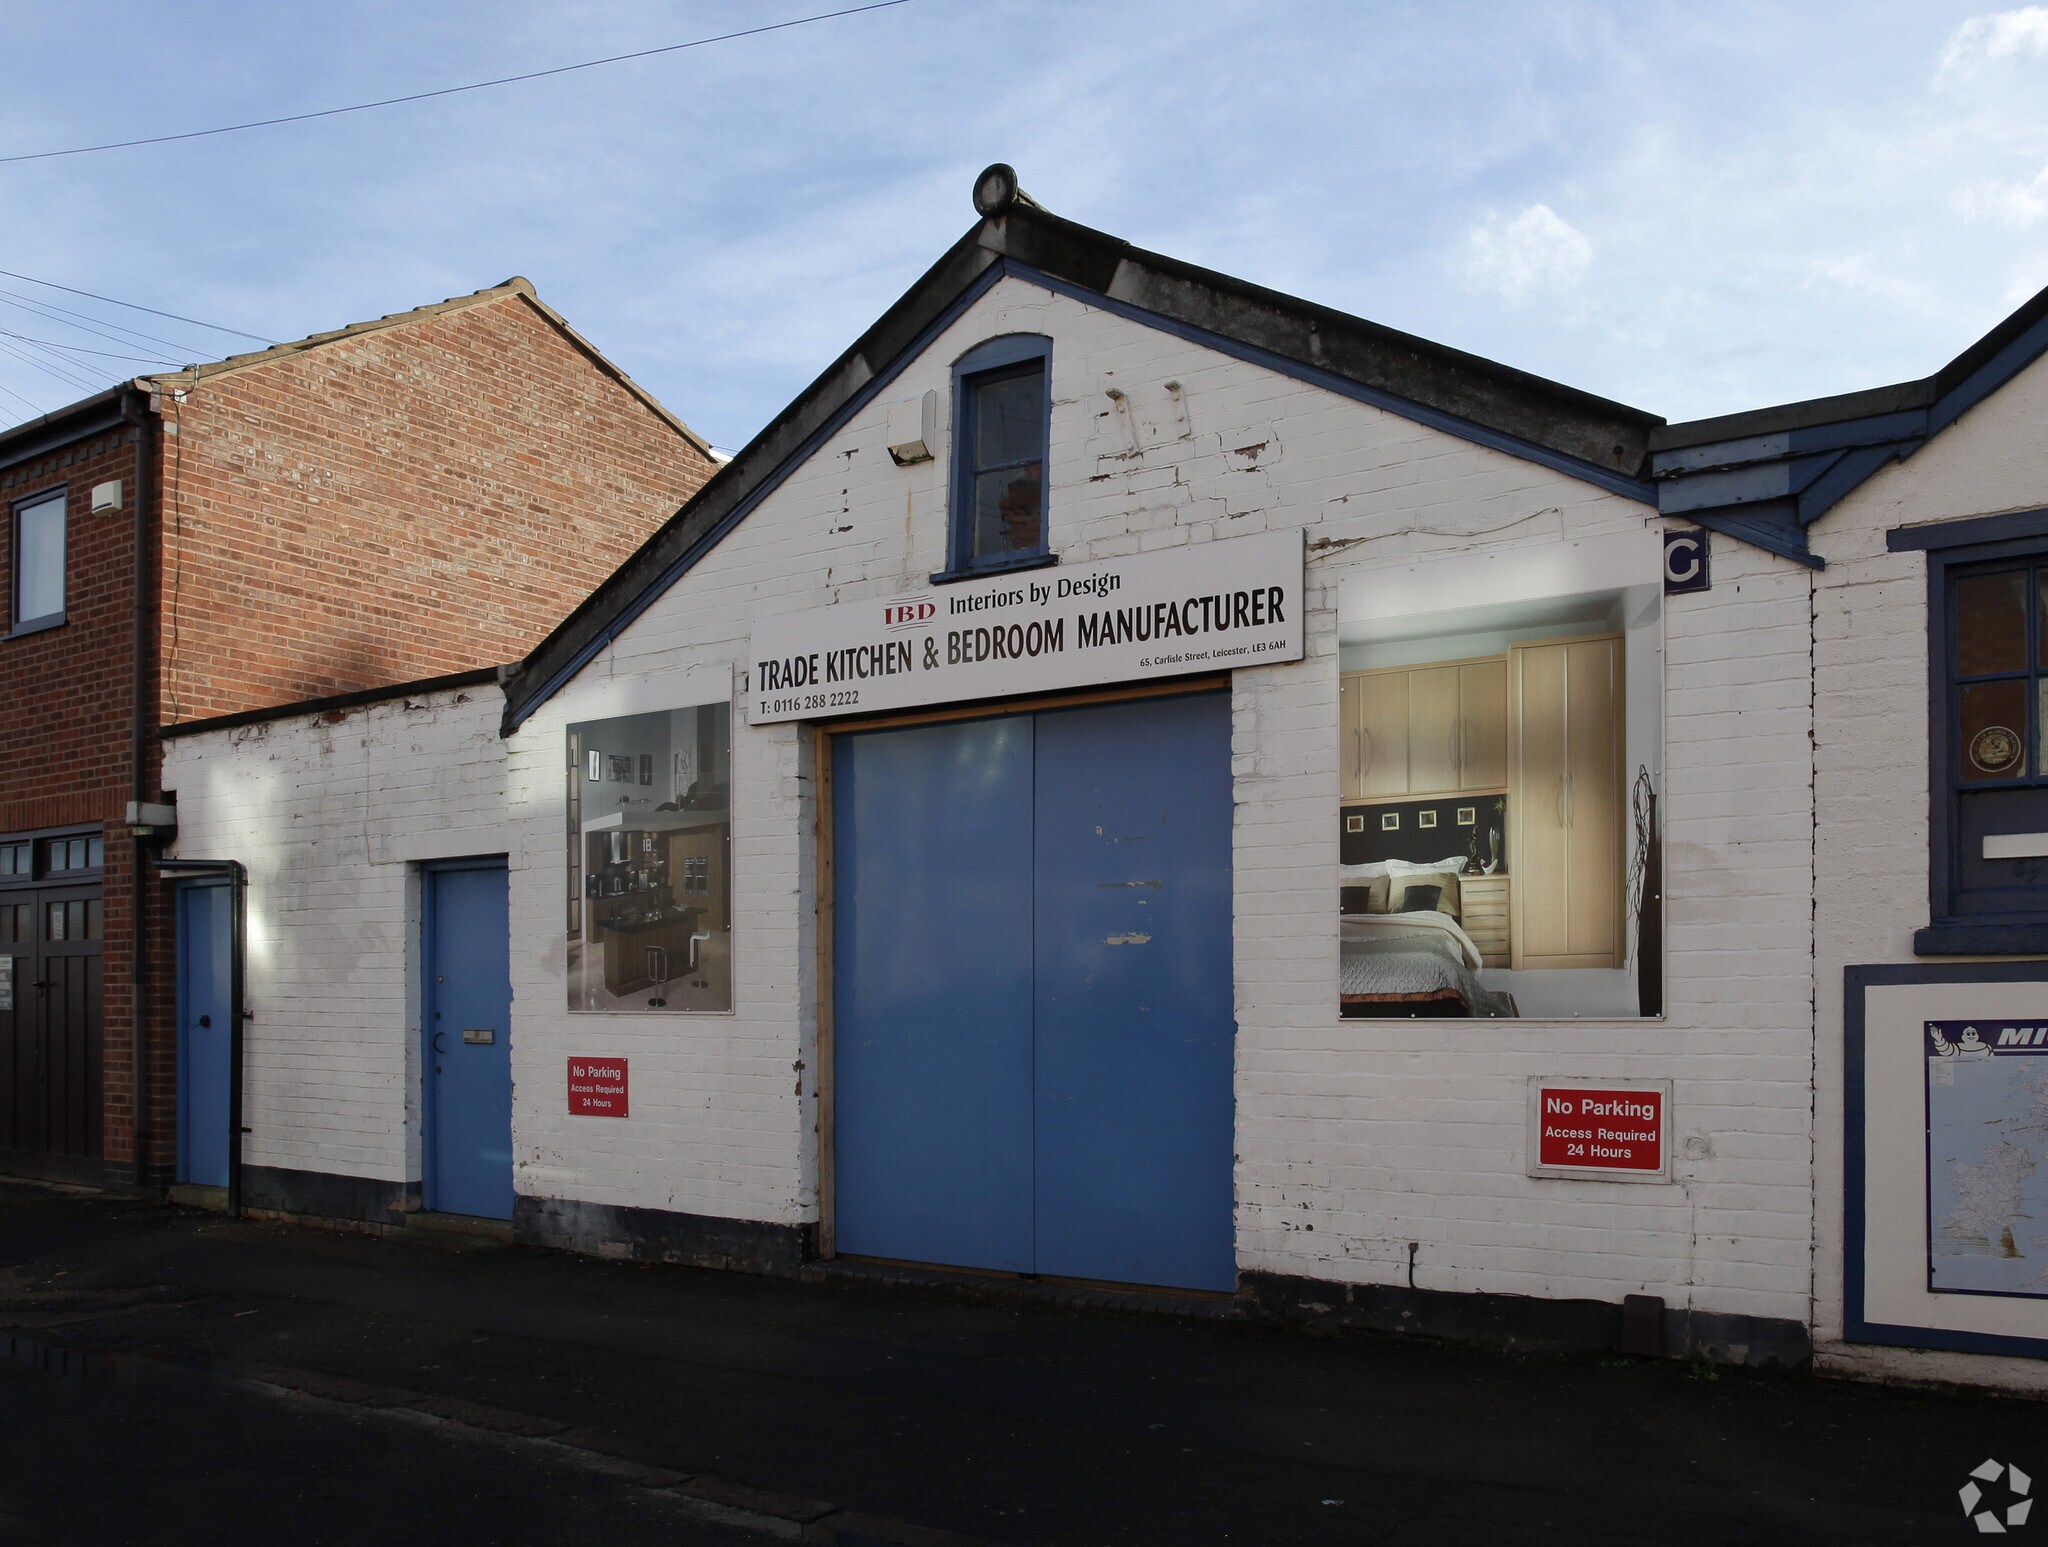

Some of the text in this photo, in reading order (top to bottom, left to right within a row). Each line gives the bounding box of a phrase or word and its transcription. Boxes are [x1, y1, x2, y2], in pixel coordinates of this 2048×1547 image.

[884, 573, 1121, 624] IBD Interiors by Design
[758, 586, 1285, 691] TRADE KITCHEN & BEDROOM MANUFACTURER
[1140, 640, 1286, 667] 65, Carlisle Street, Leicester, LE3 6AH
[761, 690, 859, 714] T: 0116 288 2222
[1998, 1028, 2048, 1045] MI
[573, 1066, 620, 1080] No Parking
[571, 1084, 624, 1094] Access Required
[583, 1098, 611, 1107] 24 Hours
[1547, 1098, 1654, 1121] No Parking
[1545, 1126, 1656, 1142] Access Required
[1567, 1144, 1632, 1158] 24 Hours
